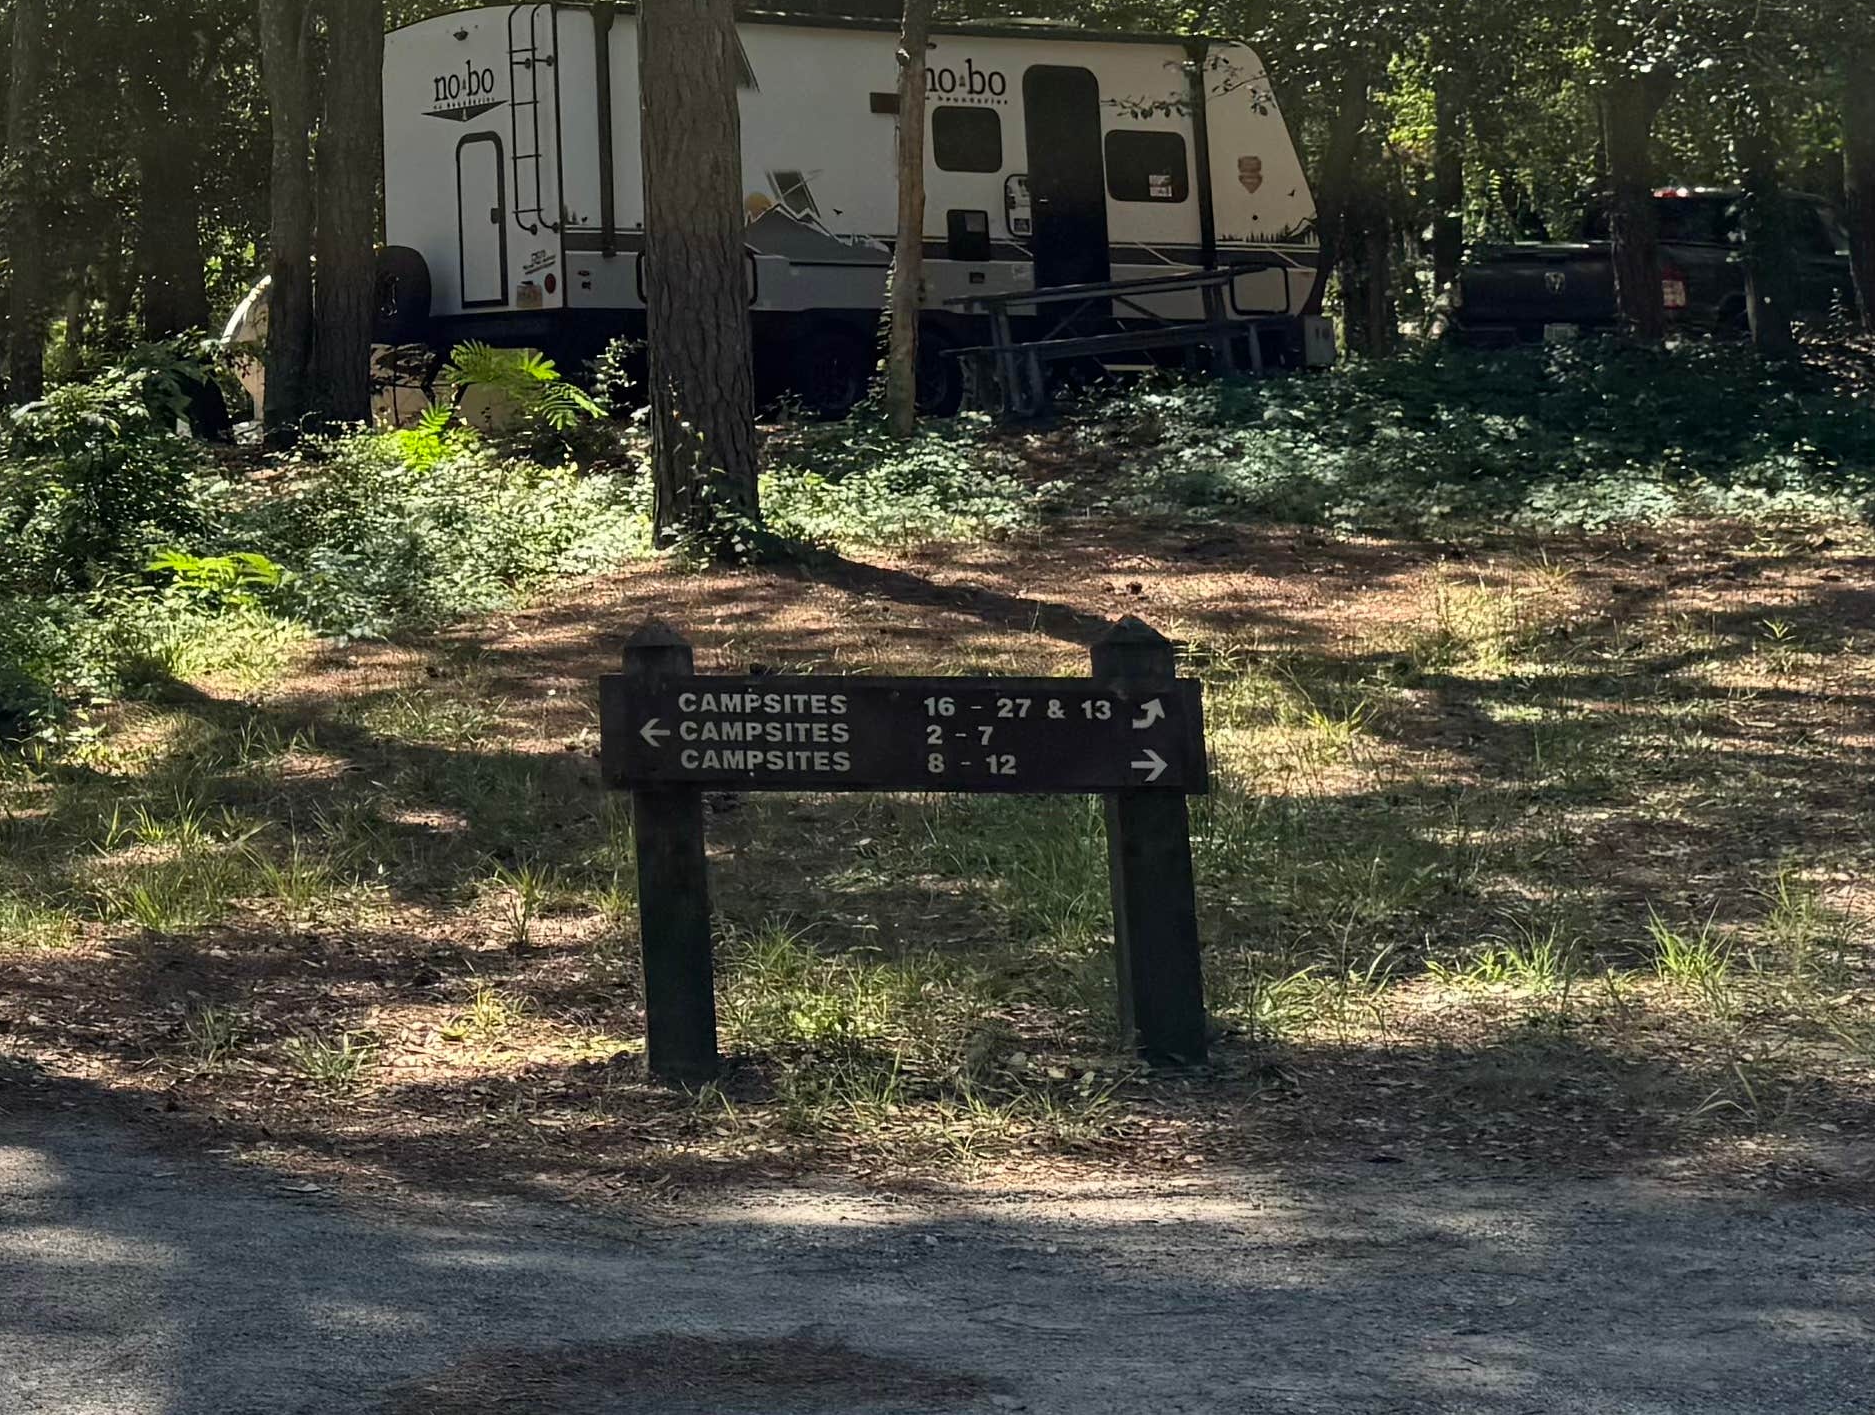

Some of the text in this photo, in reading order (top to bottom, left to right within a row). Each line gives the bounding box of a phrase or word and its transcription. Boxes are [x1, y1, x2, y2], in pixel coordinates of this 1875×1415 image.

[678, 692, 848, 714] CAMPSITES
[924, 696, 956, 717] 16
[996, 698, 1032, 718] 27
[1047, 699, 1066, 719] &
[1081, 700, 1112, 720] 13
[679, 721, 850, 743] CAMPSITES
[926, 724, 943, 745] 2
[978, 726, 994, 746] 7
[680, 749, 851, 771] CAMPSITES
[927, 753, 946, 773] 8
[985, 754, 1017, 775] 12
